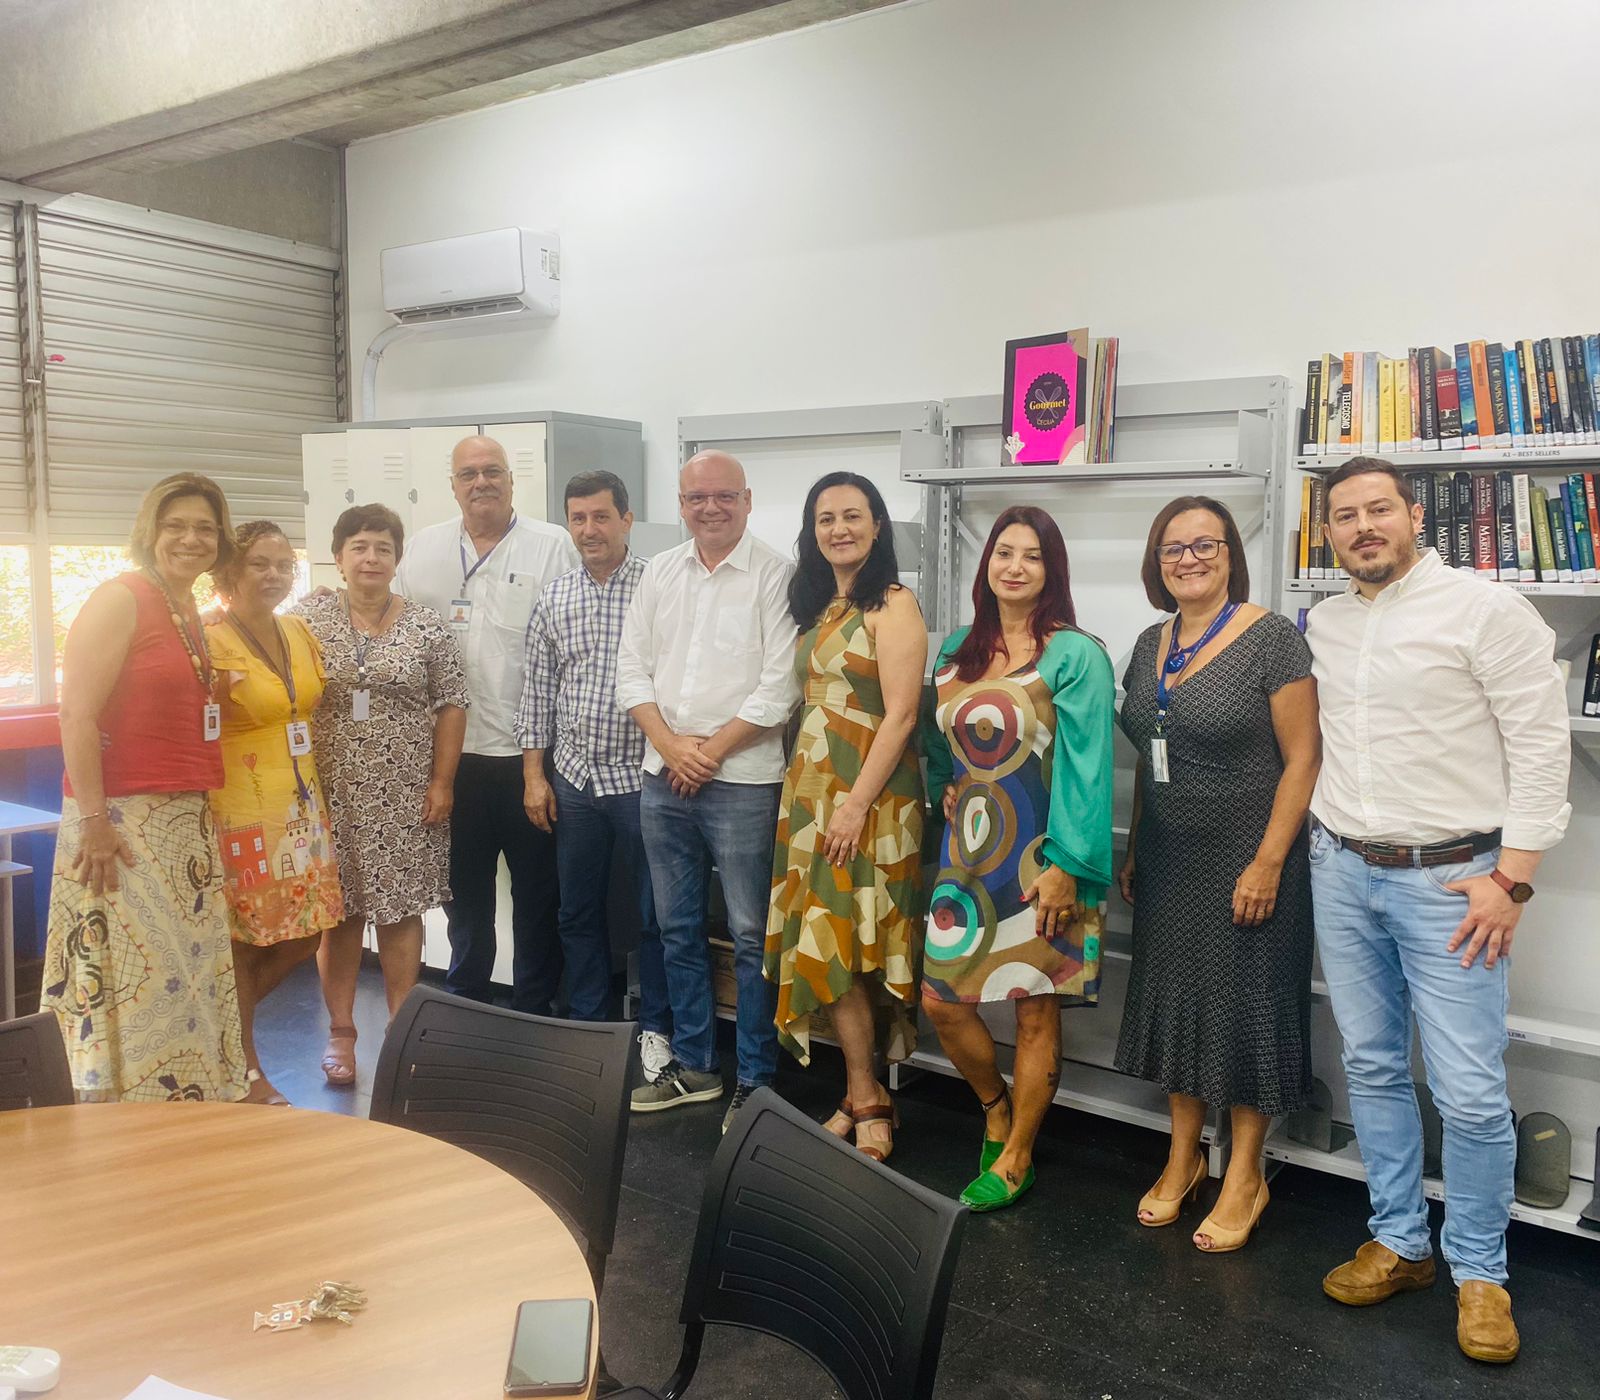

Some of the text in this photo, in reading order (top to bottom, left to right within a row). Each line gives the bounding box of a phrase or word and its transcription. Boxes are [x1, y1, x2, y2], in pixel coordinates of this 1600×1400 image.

[1030, 398, 1066, 410] Gourmet
[1342, 391, 1352, 429] TELECOSMO
[1494, 380, 1503, 402] PAPISA
[1438, 526, 1449, 565] MARTIN
[1458, 523, 1470, 561] MARTIN
[1480, 525, 1491, 563] MARTIN
[1502, 522, 1514, 561] MARTIN
